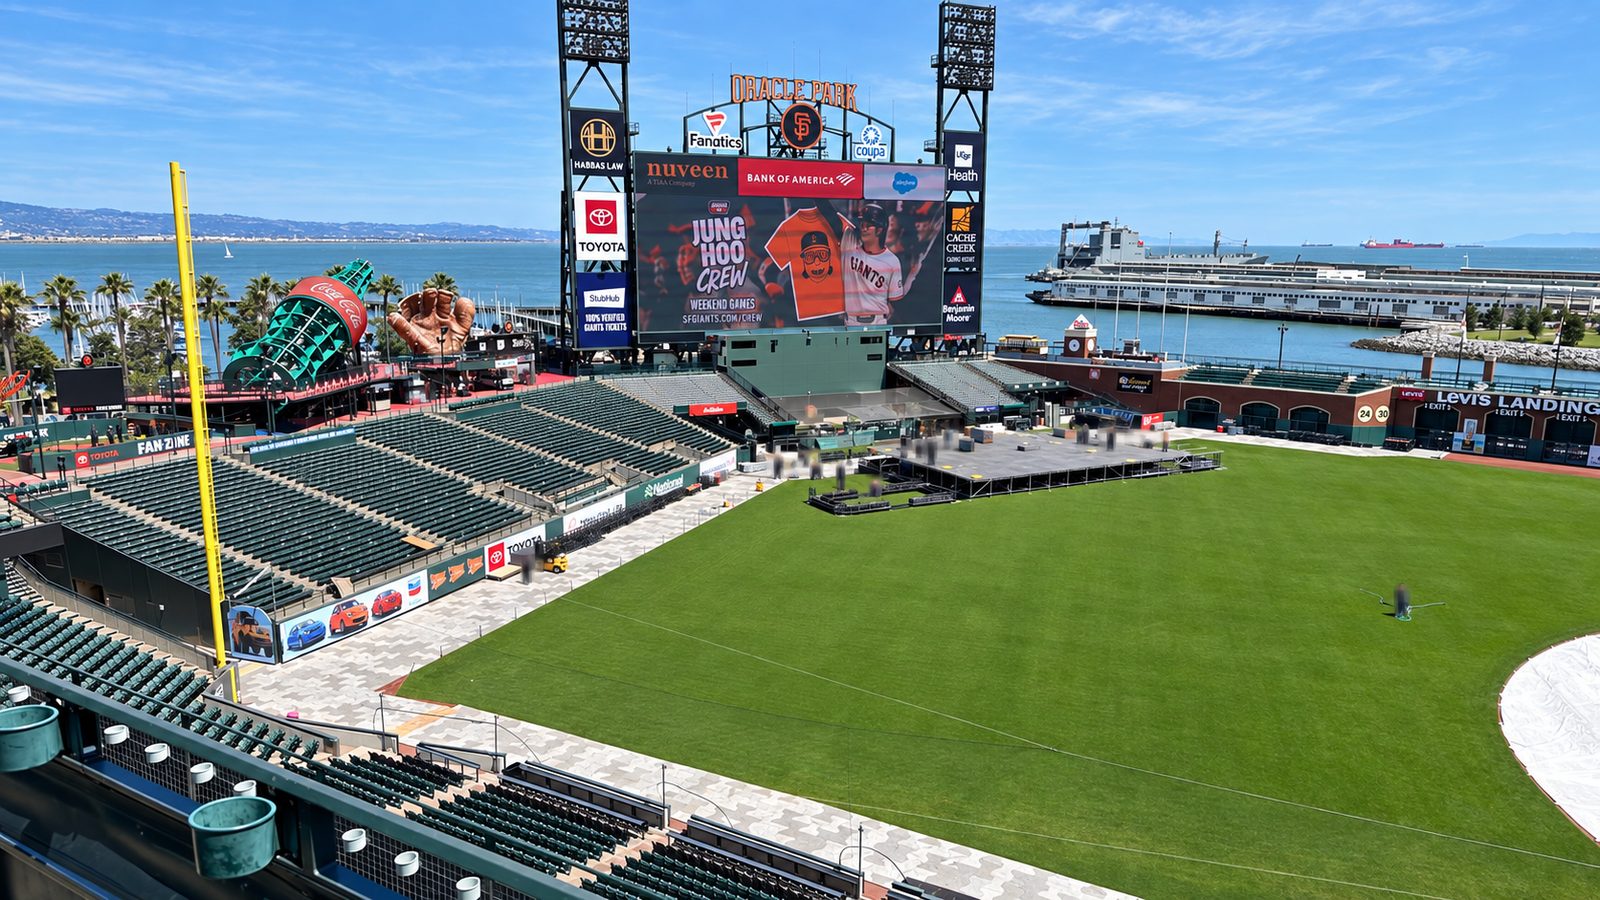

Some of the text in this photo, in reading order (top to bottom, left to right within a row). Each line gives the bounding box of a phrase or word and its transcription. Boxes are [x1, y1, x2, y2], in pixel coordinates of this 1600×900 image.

[731, 73, 858, 112] ORACLE PARK
[794, 112, 811, 141] SF
[690, 133, 742, 149] Fanatics
[856, 145, 886, 158] coupa
[607, 162, 624, 171] LAW
[647, 162, 729, 179] nuveen
[747, 173, 835, 185] BANK OF AMERICA
[692, 216, 746, 247] JUNG
[946, 233, 977, 243] CACHE
[579, 242, 626, 252] TOYOTA
[946, 243, 976, 253] CREEK
[700, 240, 746, 268] HOO
[696, 261, 749, 295] CREW
[850, 256, 885, 289] GIANTS
[589, 294, 620, 303] StubHub
[690, 298, 756, 310] WEEKEND GAMES
[943, 304, 975, 314] Benjamin
[682, 313, 763, 324] SFGIANTS.COM/CREW
[946, 314, 970, 322] Moore
[1360, 410, 1388, 418] 24 30
[1561, 413, 1580, 422] EXIT
[652, 473, 684, 492] National
